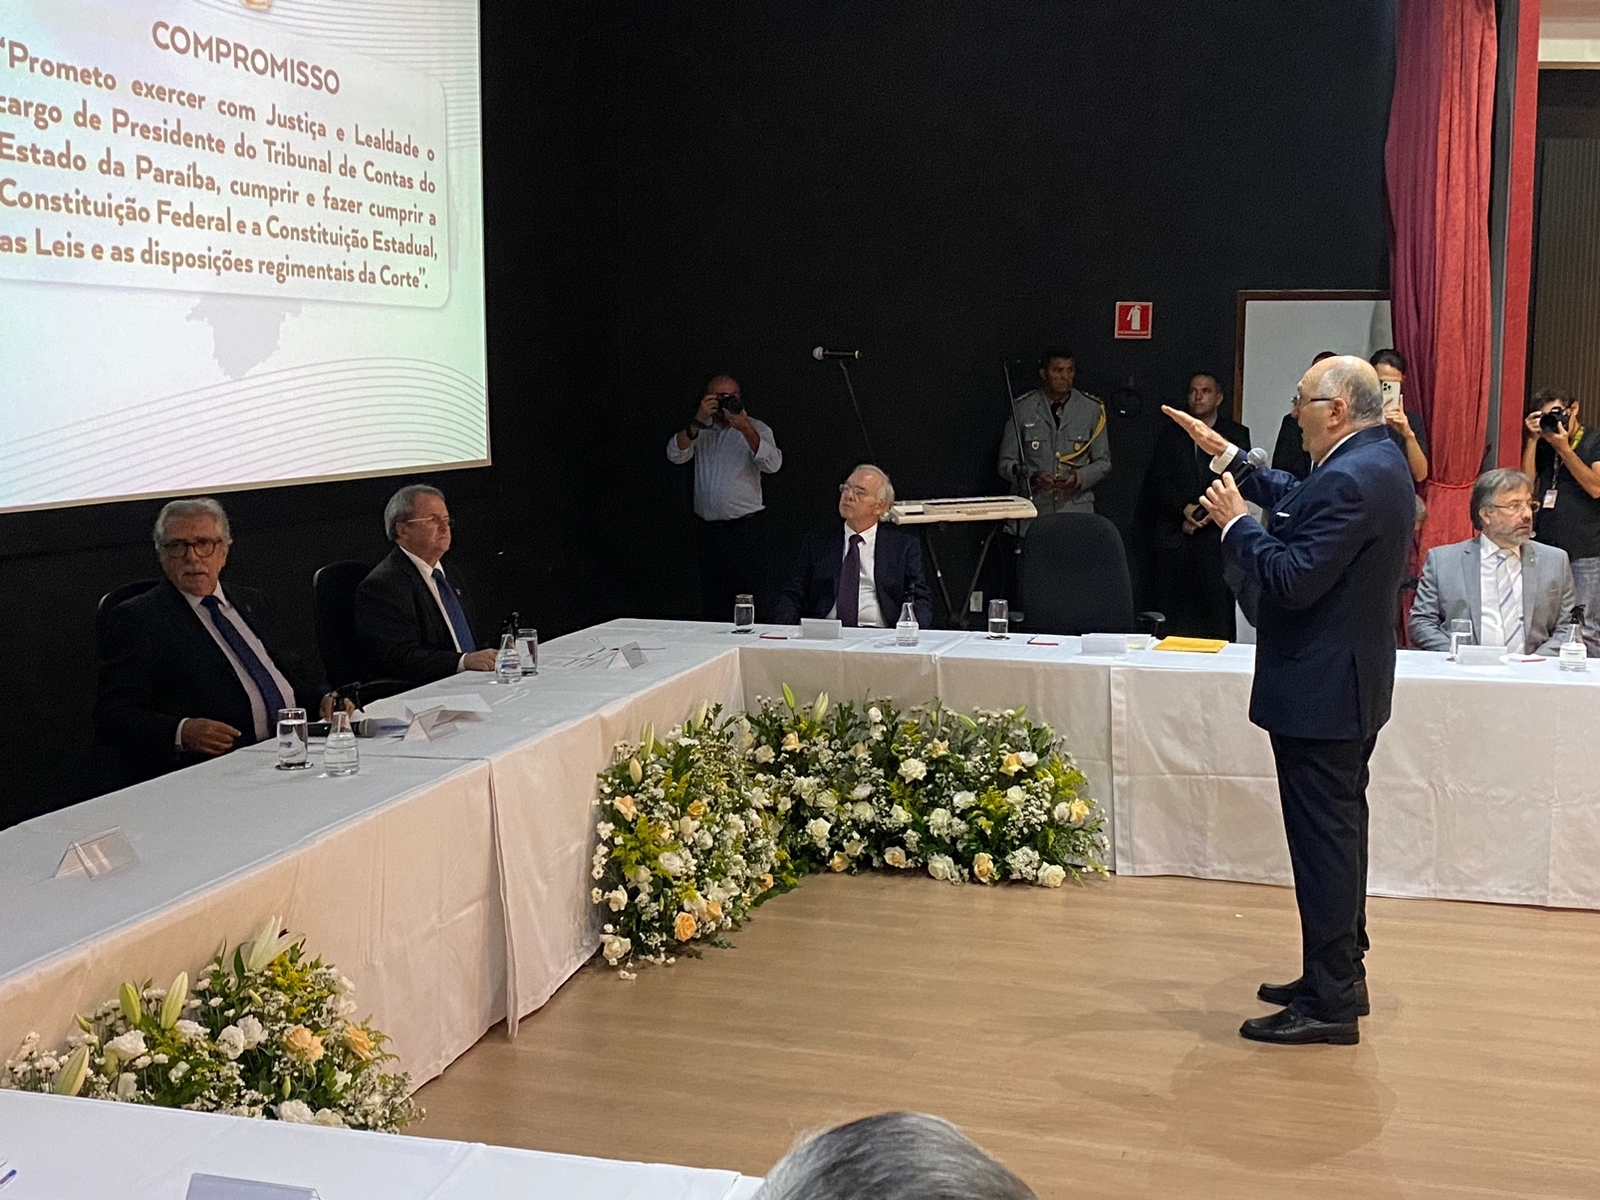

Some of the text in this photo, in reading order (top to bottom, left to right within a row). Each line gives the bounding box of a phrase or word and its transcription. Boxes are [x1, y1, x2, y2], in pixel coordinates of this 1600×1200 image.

[151, 20, 340, 95] COMPROMISSO
[73, 98, 102, 131] de
[112, 107, 226, 155] Presidente
[233, 131, 257, 160] do
[262, 138, 332, 175] Tribunal
[338, 153, 357, 179] de
[363, 160, 414, 191] Contas
[419, 170, 436, 194] do
[131, 79, 206, 110] exercer
[217, 99, 256, 122] com
[265, 102, 327, 140] Justiça
[336, 127, 345, 142] e
[354, 123, 420, 159] Lealdade
[426, 148, 435, 162] o
[0, 131, 437, 227] Estado da Paraíba, cumprir e fazer cumprir a
[0, 177, 438, 261] Constituição Federal e a Constituição Estadual,
[0, 234, 28, 254] as
[35, 227, 86, 259] Leis
[91, 243, 105, 261] e
[110, 245, 135, 263] as
[140, 236, 254, 277] disposições
[258, 254, 355, 284] regimentais
[358, 260, 377, 285] da
